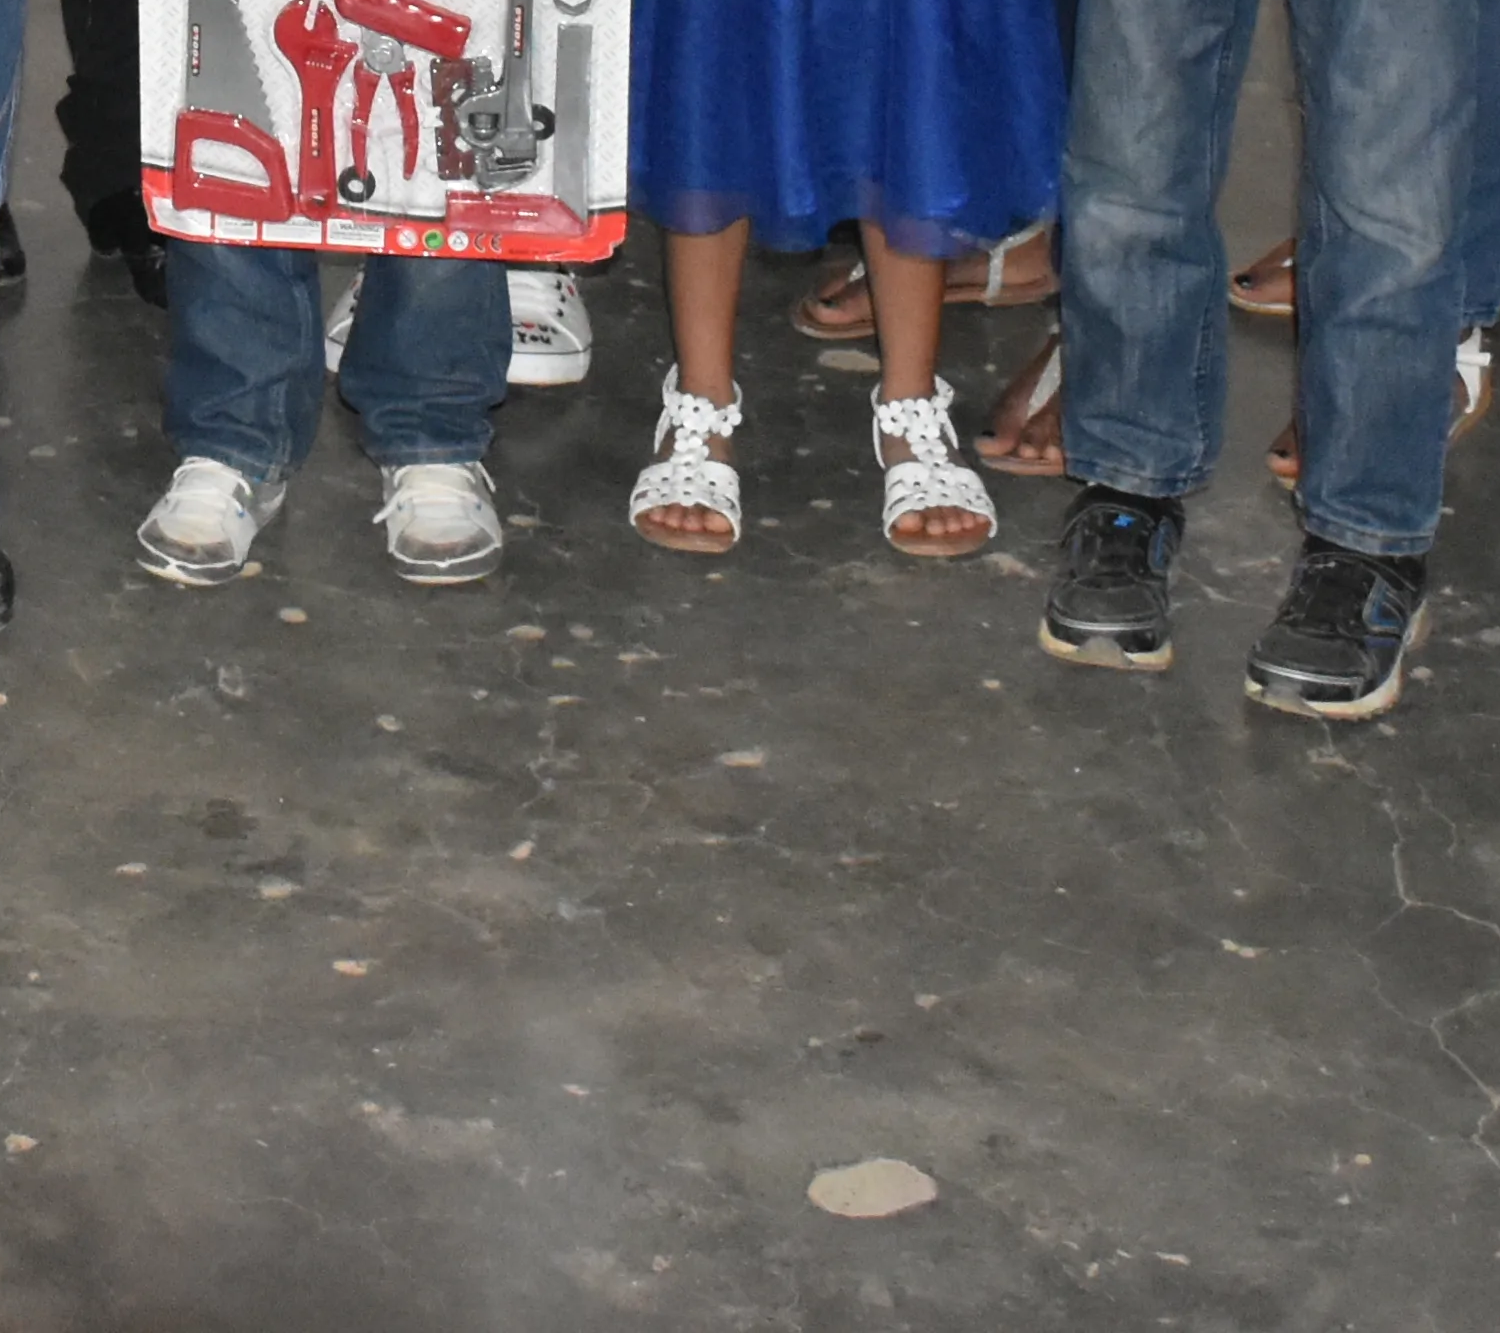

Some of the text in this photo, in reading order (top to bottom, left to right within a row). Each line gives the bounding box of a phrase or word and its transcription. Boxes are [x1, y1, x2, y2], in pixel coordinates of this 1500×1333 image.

[191, 25, 200, 66] TOOLS
[514, 6, 523, 48] TOOLS
[311, 108, 319, 148] TOOLS
